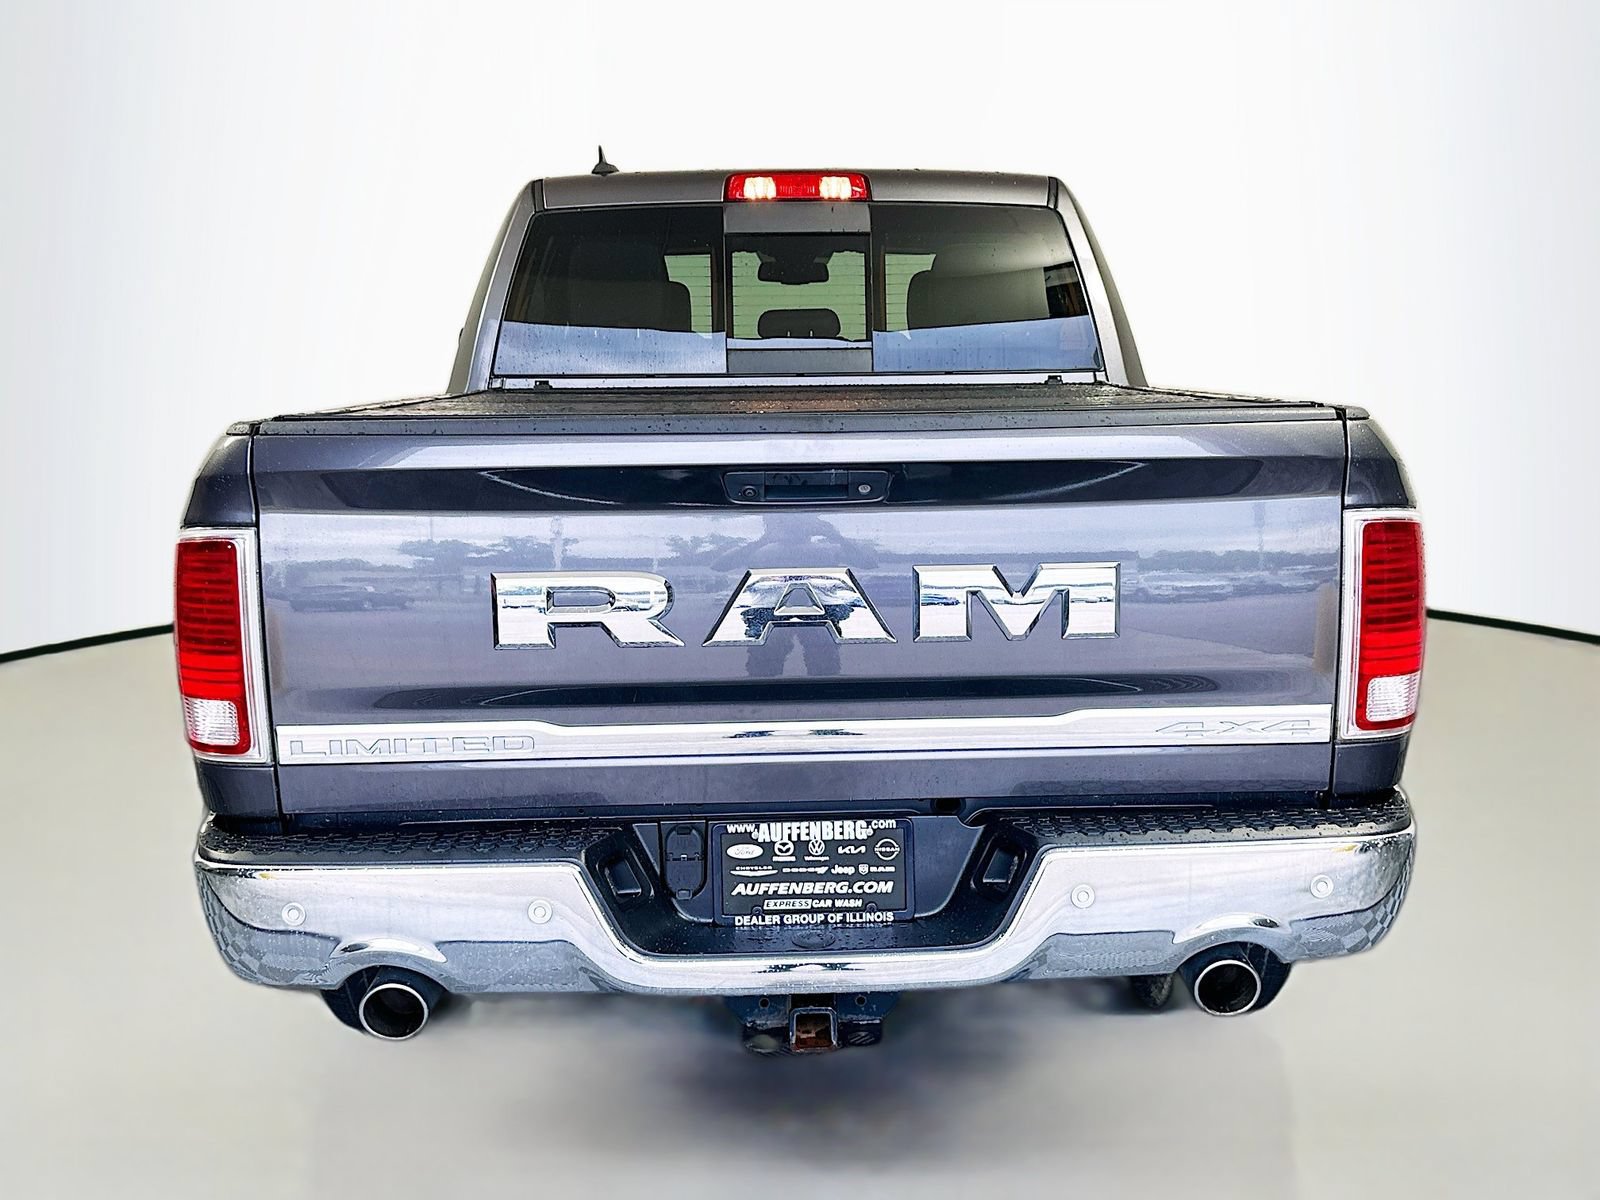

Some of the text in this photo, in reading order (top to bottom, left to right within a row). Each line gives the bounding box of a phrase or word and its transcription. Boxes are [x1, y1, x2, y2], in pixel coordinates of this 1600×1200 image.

[490, 561, 1122, 650] RAM
[289, 735, 535, 756] LIMITED
[830, 864, 856, 875] Jeep
[731, 881, 894, 896] AUFFENBERG.COM
[765, 899, 863, 909] EXPRESS CAR WASH
[735, 912, 894, 926] DEALER GROUP OF ILLINOIS
